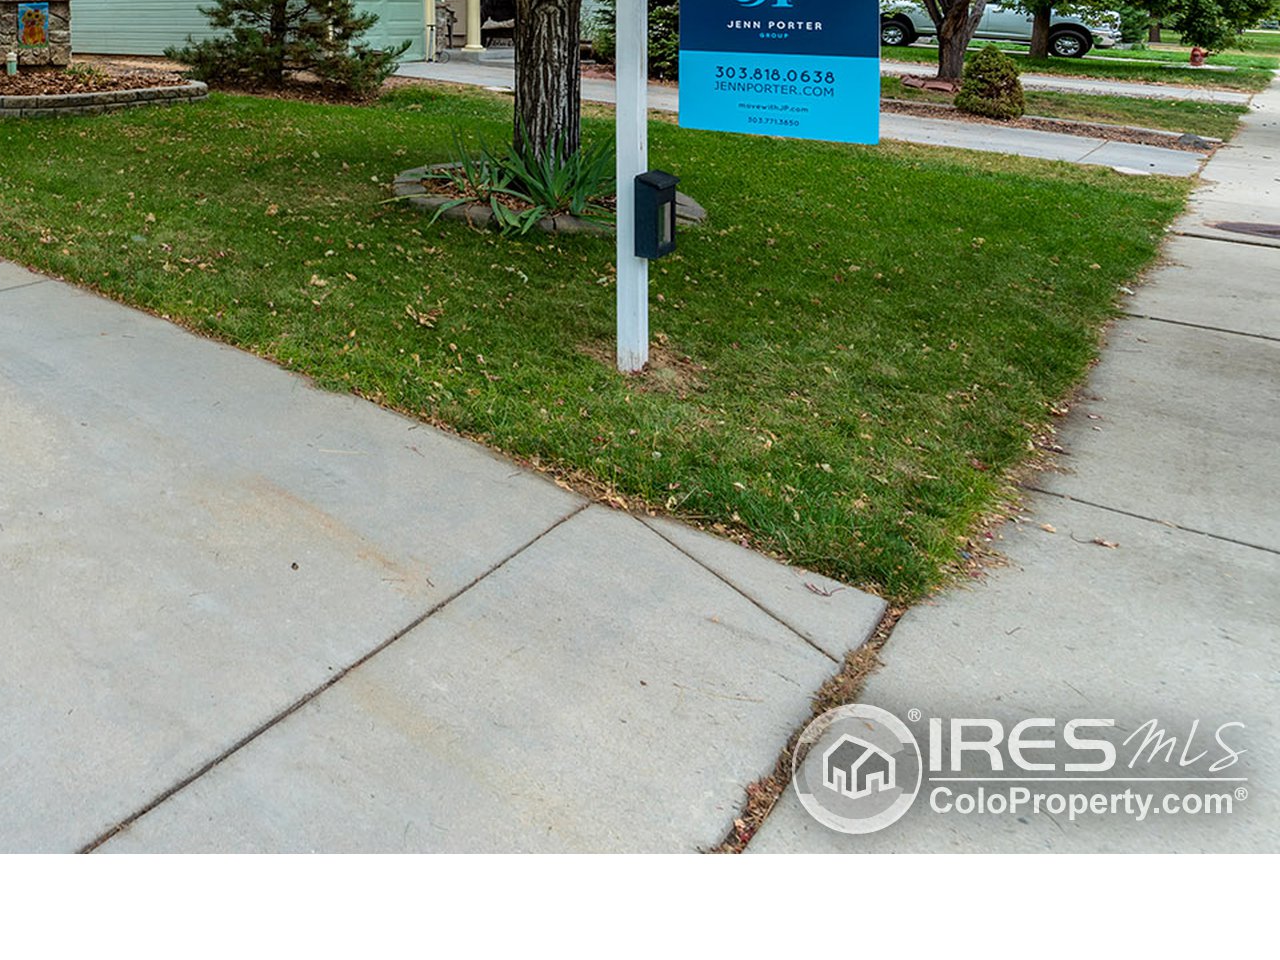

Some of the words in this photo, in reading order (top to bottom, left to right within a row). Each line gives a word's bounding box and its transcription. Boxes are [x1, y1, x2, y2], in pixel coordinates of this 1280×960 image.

[727, 20, 761, 29] JENN
[768, 21, 822, 30] PORTER
[715, 65, 835, 84] 303.818.0638
[714, 81, 835, 97] JENNPORTER.COM
